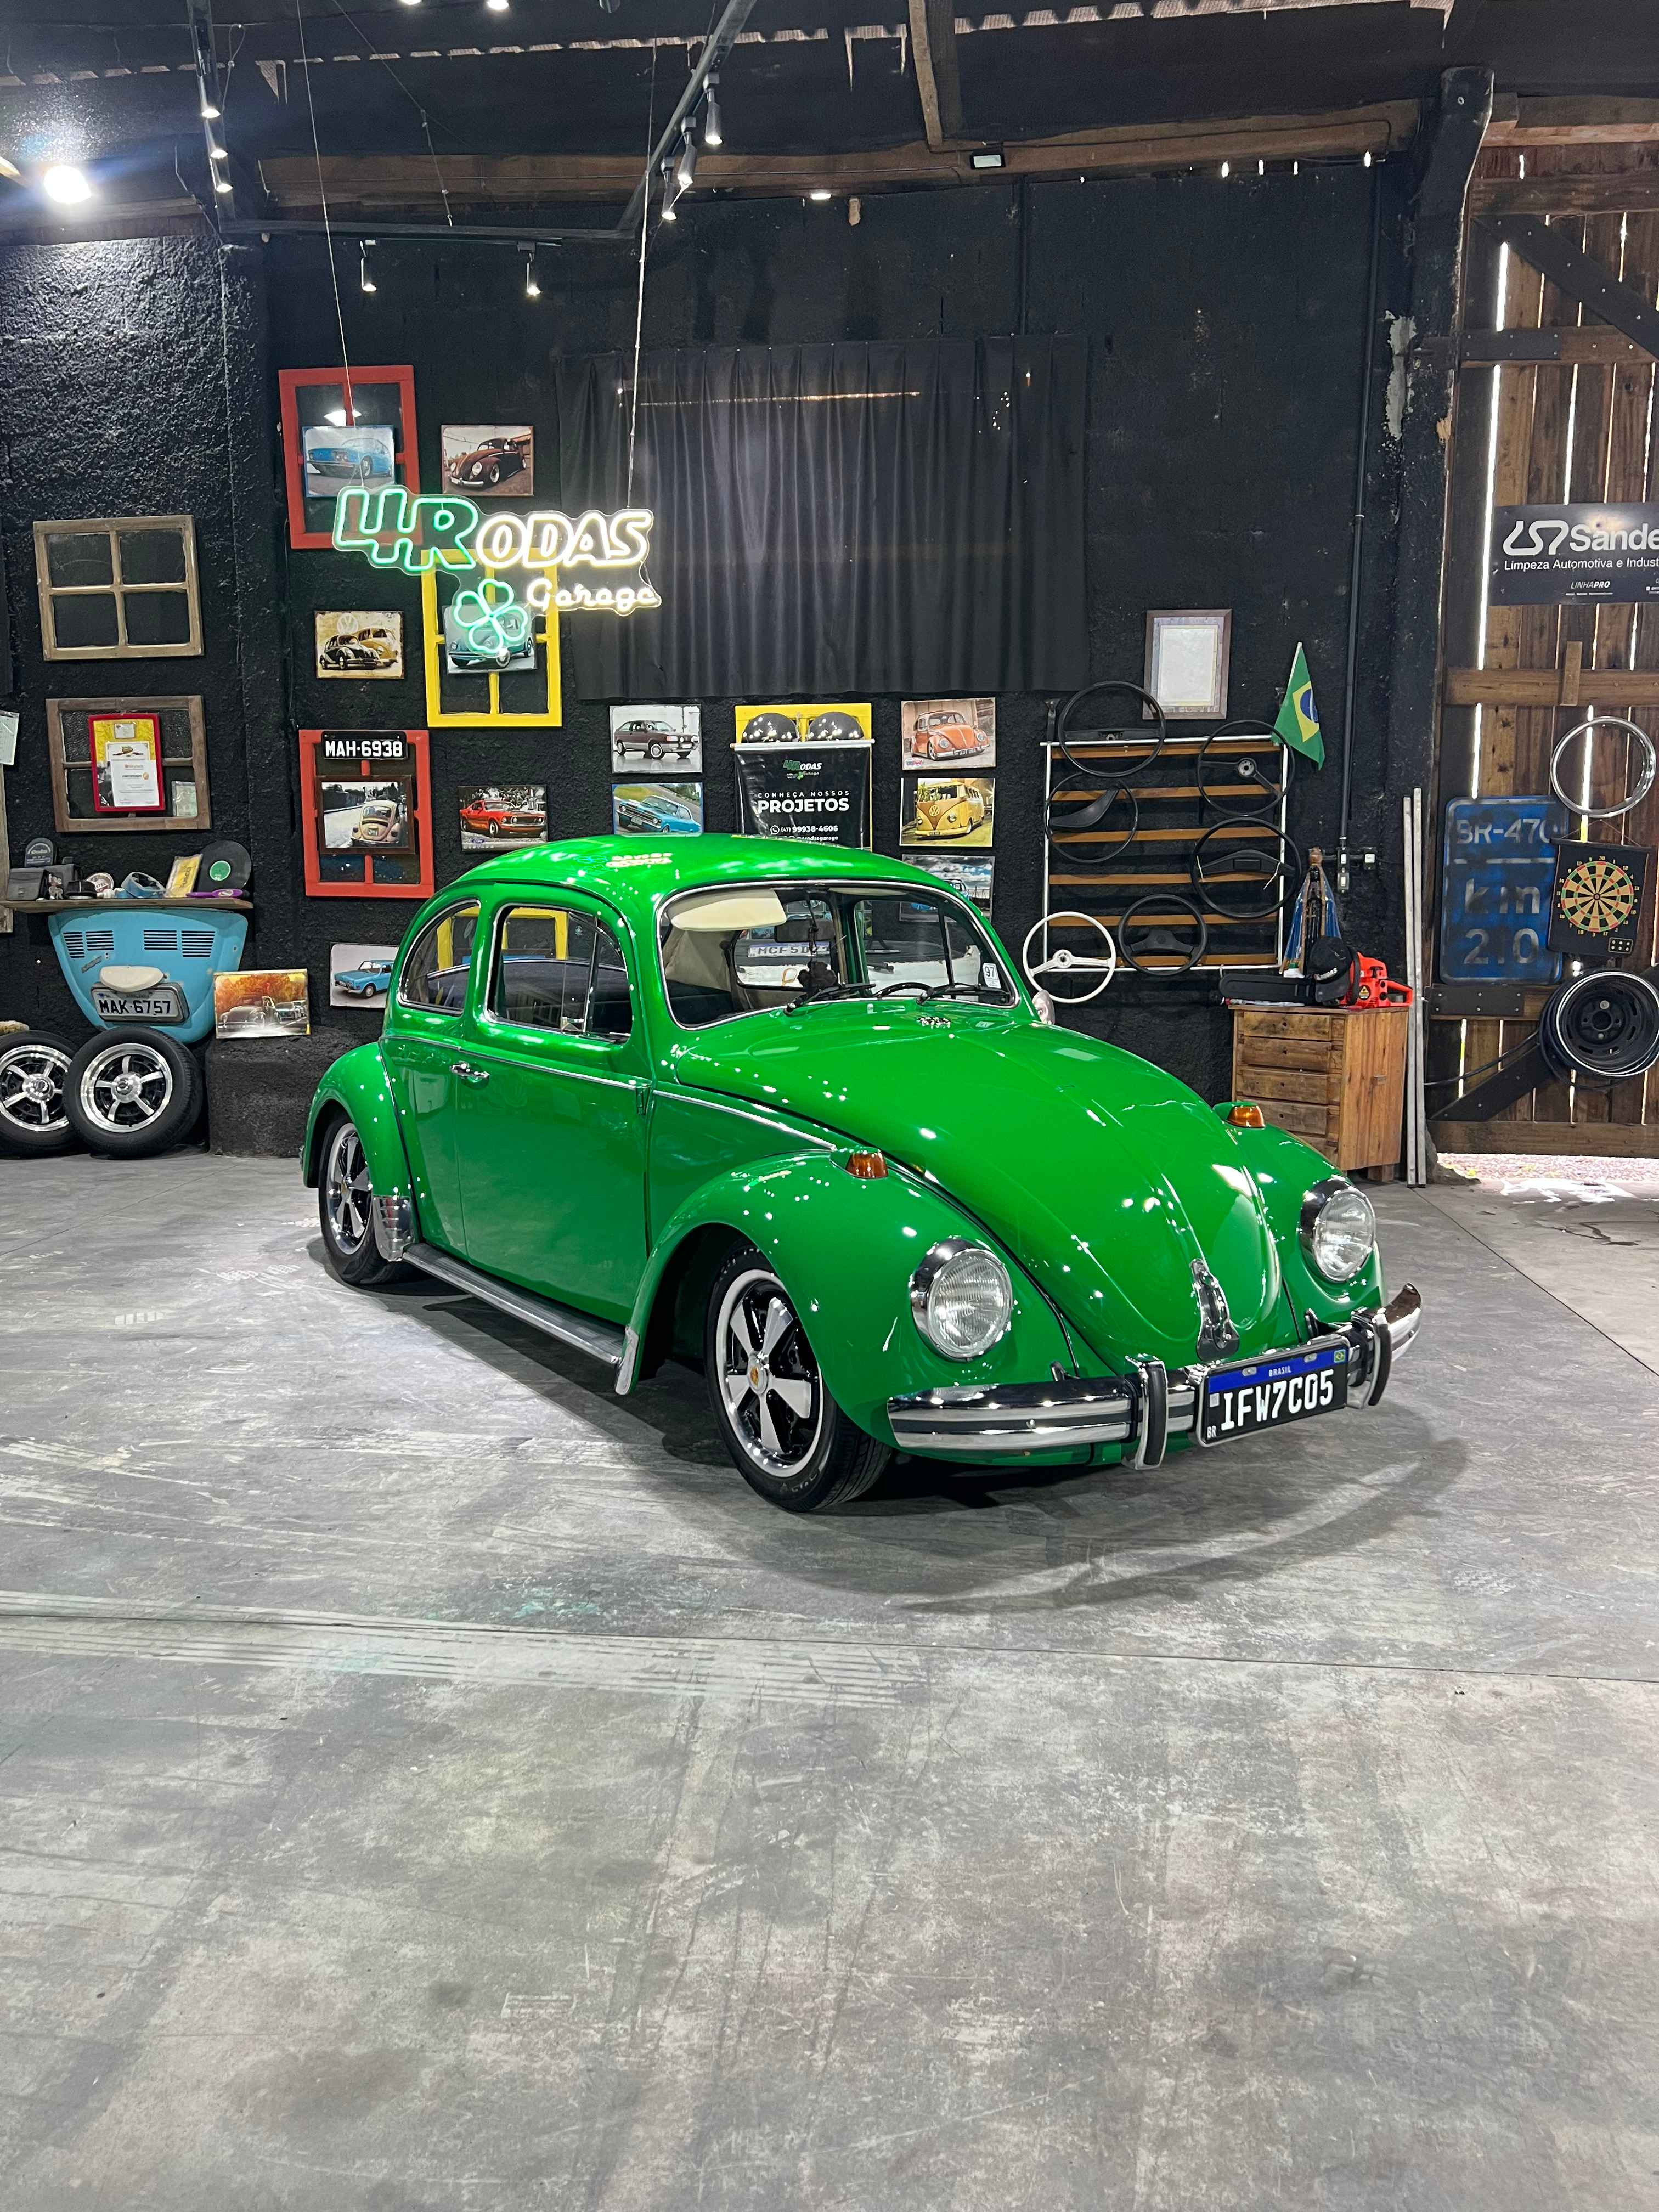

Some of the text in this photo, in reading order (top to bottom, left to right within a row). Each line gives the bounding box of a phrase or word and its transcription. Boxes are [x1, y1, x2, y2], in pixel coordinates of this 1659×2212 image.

[1570, 523, 1659, 552] Sande
[1504, 560, 1550, 572] Limpeza
[1553, 557, 1613, 569] Automotiva
[526, 577, 660, 612] Garage
[758, 797, 849, 814] PROJETOS
[792, 825, 838, 833] 99938-4606
[1465, 878, 1541, 914] km
[984, 966, 994, 977] 97
[1268, 1366, 1291, 1376] BRASIL
[1221, 1369, 1334, 1431] IFW7C05
[1207, 1426, 1216, 1438] BR
